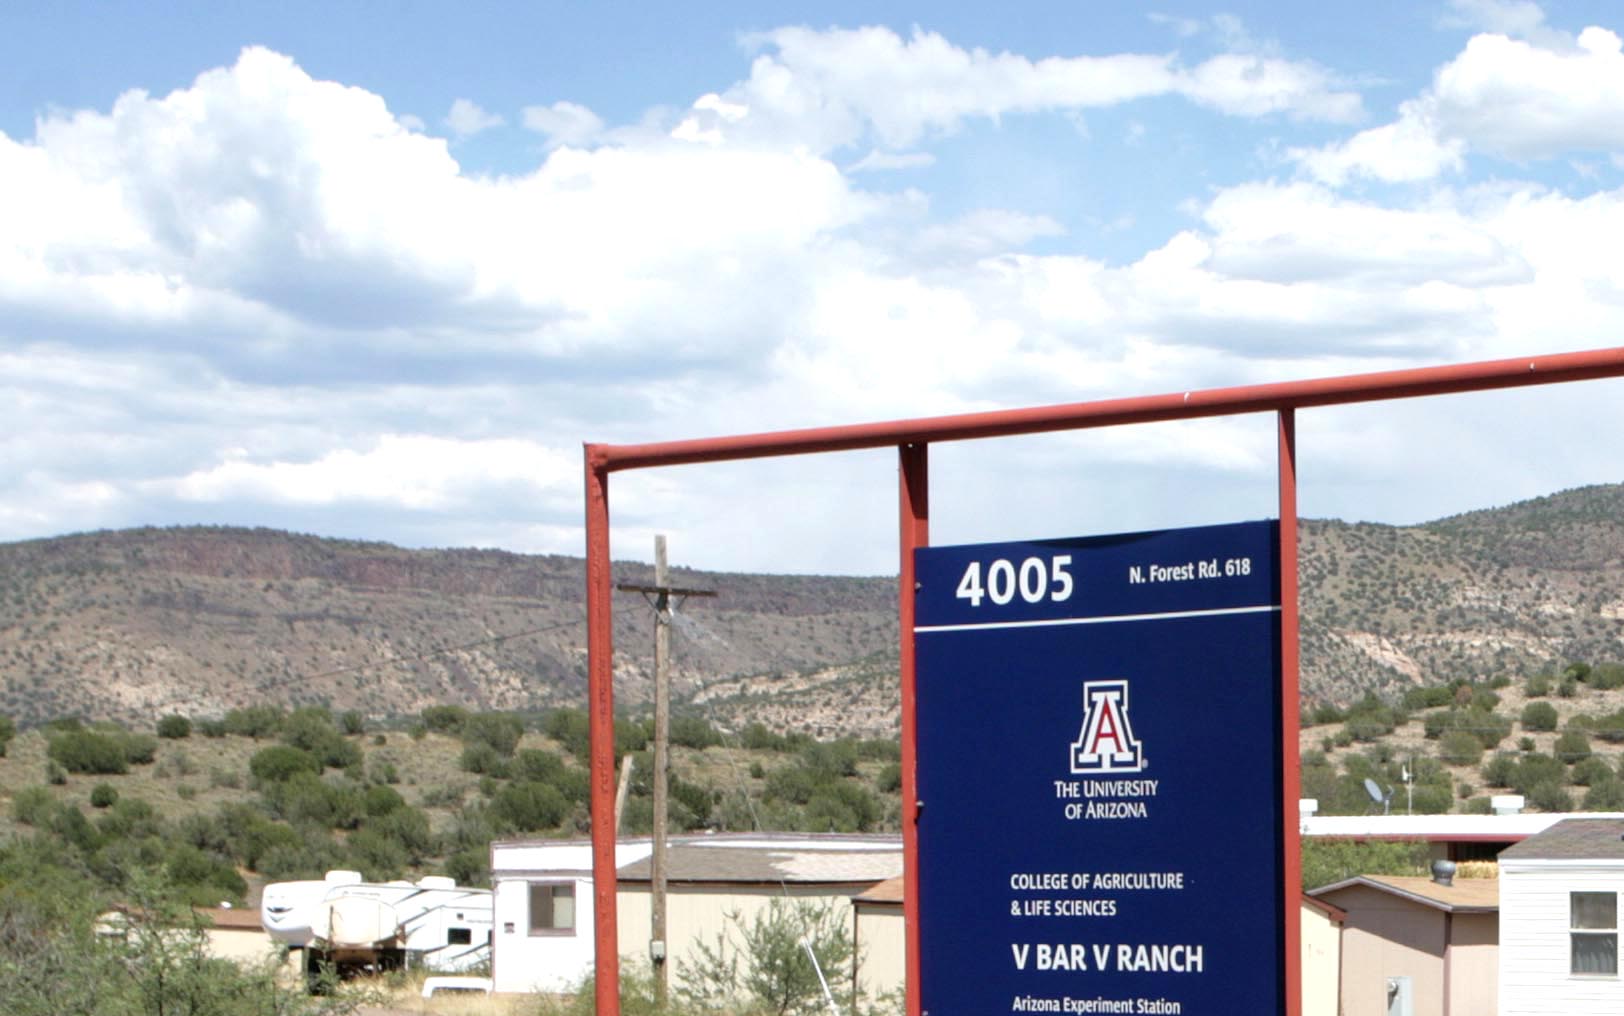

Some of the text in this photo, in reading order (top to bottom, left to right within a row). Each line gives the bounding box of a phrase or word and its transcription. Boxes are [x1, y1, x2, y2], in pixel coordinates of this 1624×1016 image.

[955, 554, 1074, 607] 4005
[1129, 557, 1251, 584] N. Forest Rd. 618
[1054, 779, 1159, 798] THE UNIVERSITY
[1065, 800, 1148, 820] OF ARIZONA
[1010, 872, 1184, 890] COLLEGE OF AGRICULTURE
[1010, 899, 1117, 917] & LIFE SCIENCES
[1011, 943, 1203, 973] V BAR V RANCH
[1012, 995, 1181, 1016] Arizona Experiment Station
